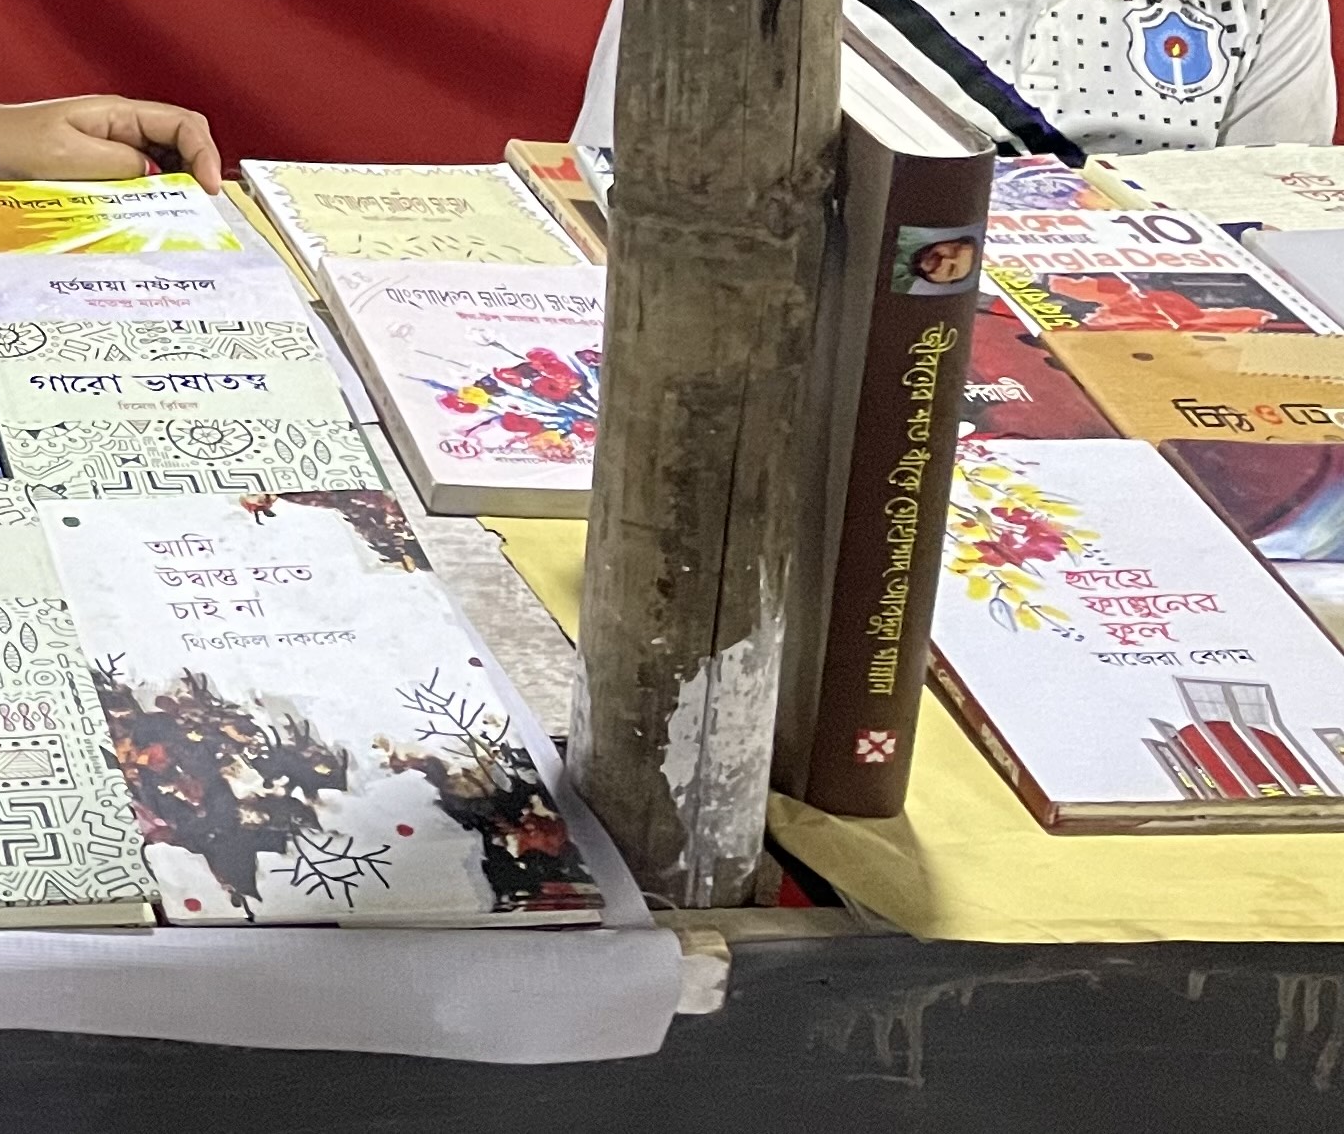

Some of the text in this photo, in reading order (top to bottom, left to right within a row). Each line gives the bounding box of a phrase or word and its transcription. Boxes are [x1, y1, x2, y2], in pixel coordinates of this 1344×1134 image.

[1112, 215, 1203, 245] 10
[30, 375, 123, 395] গারো
[1254, 404, 1284, 426] ও
[143, 534, 217, 562] আমি
[252, 563, 315, 588] হতে
[164, 593, 268, 623] চাই না
[865, 577, 908, 641] আবদুল
[181, 627, 357, 654] থিওফিল নকরেক
[1100, 622, 1179, 648] ফুল
[1091, 647, 1256, 668] হাজেরা বেগম
